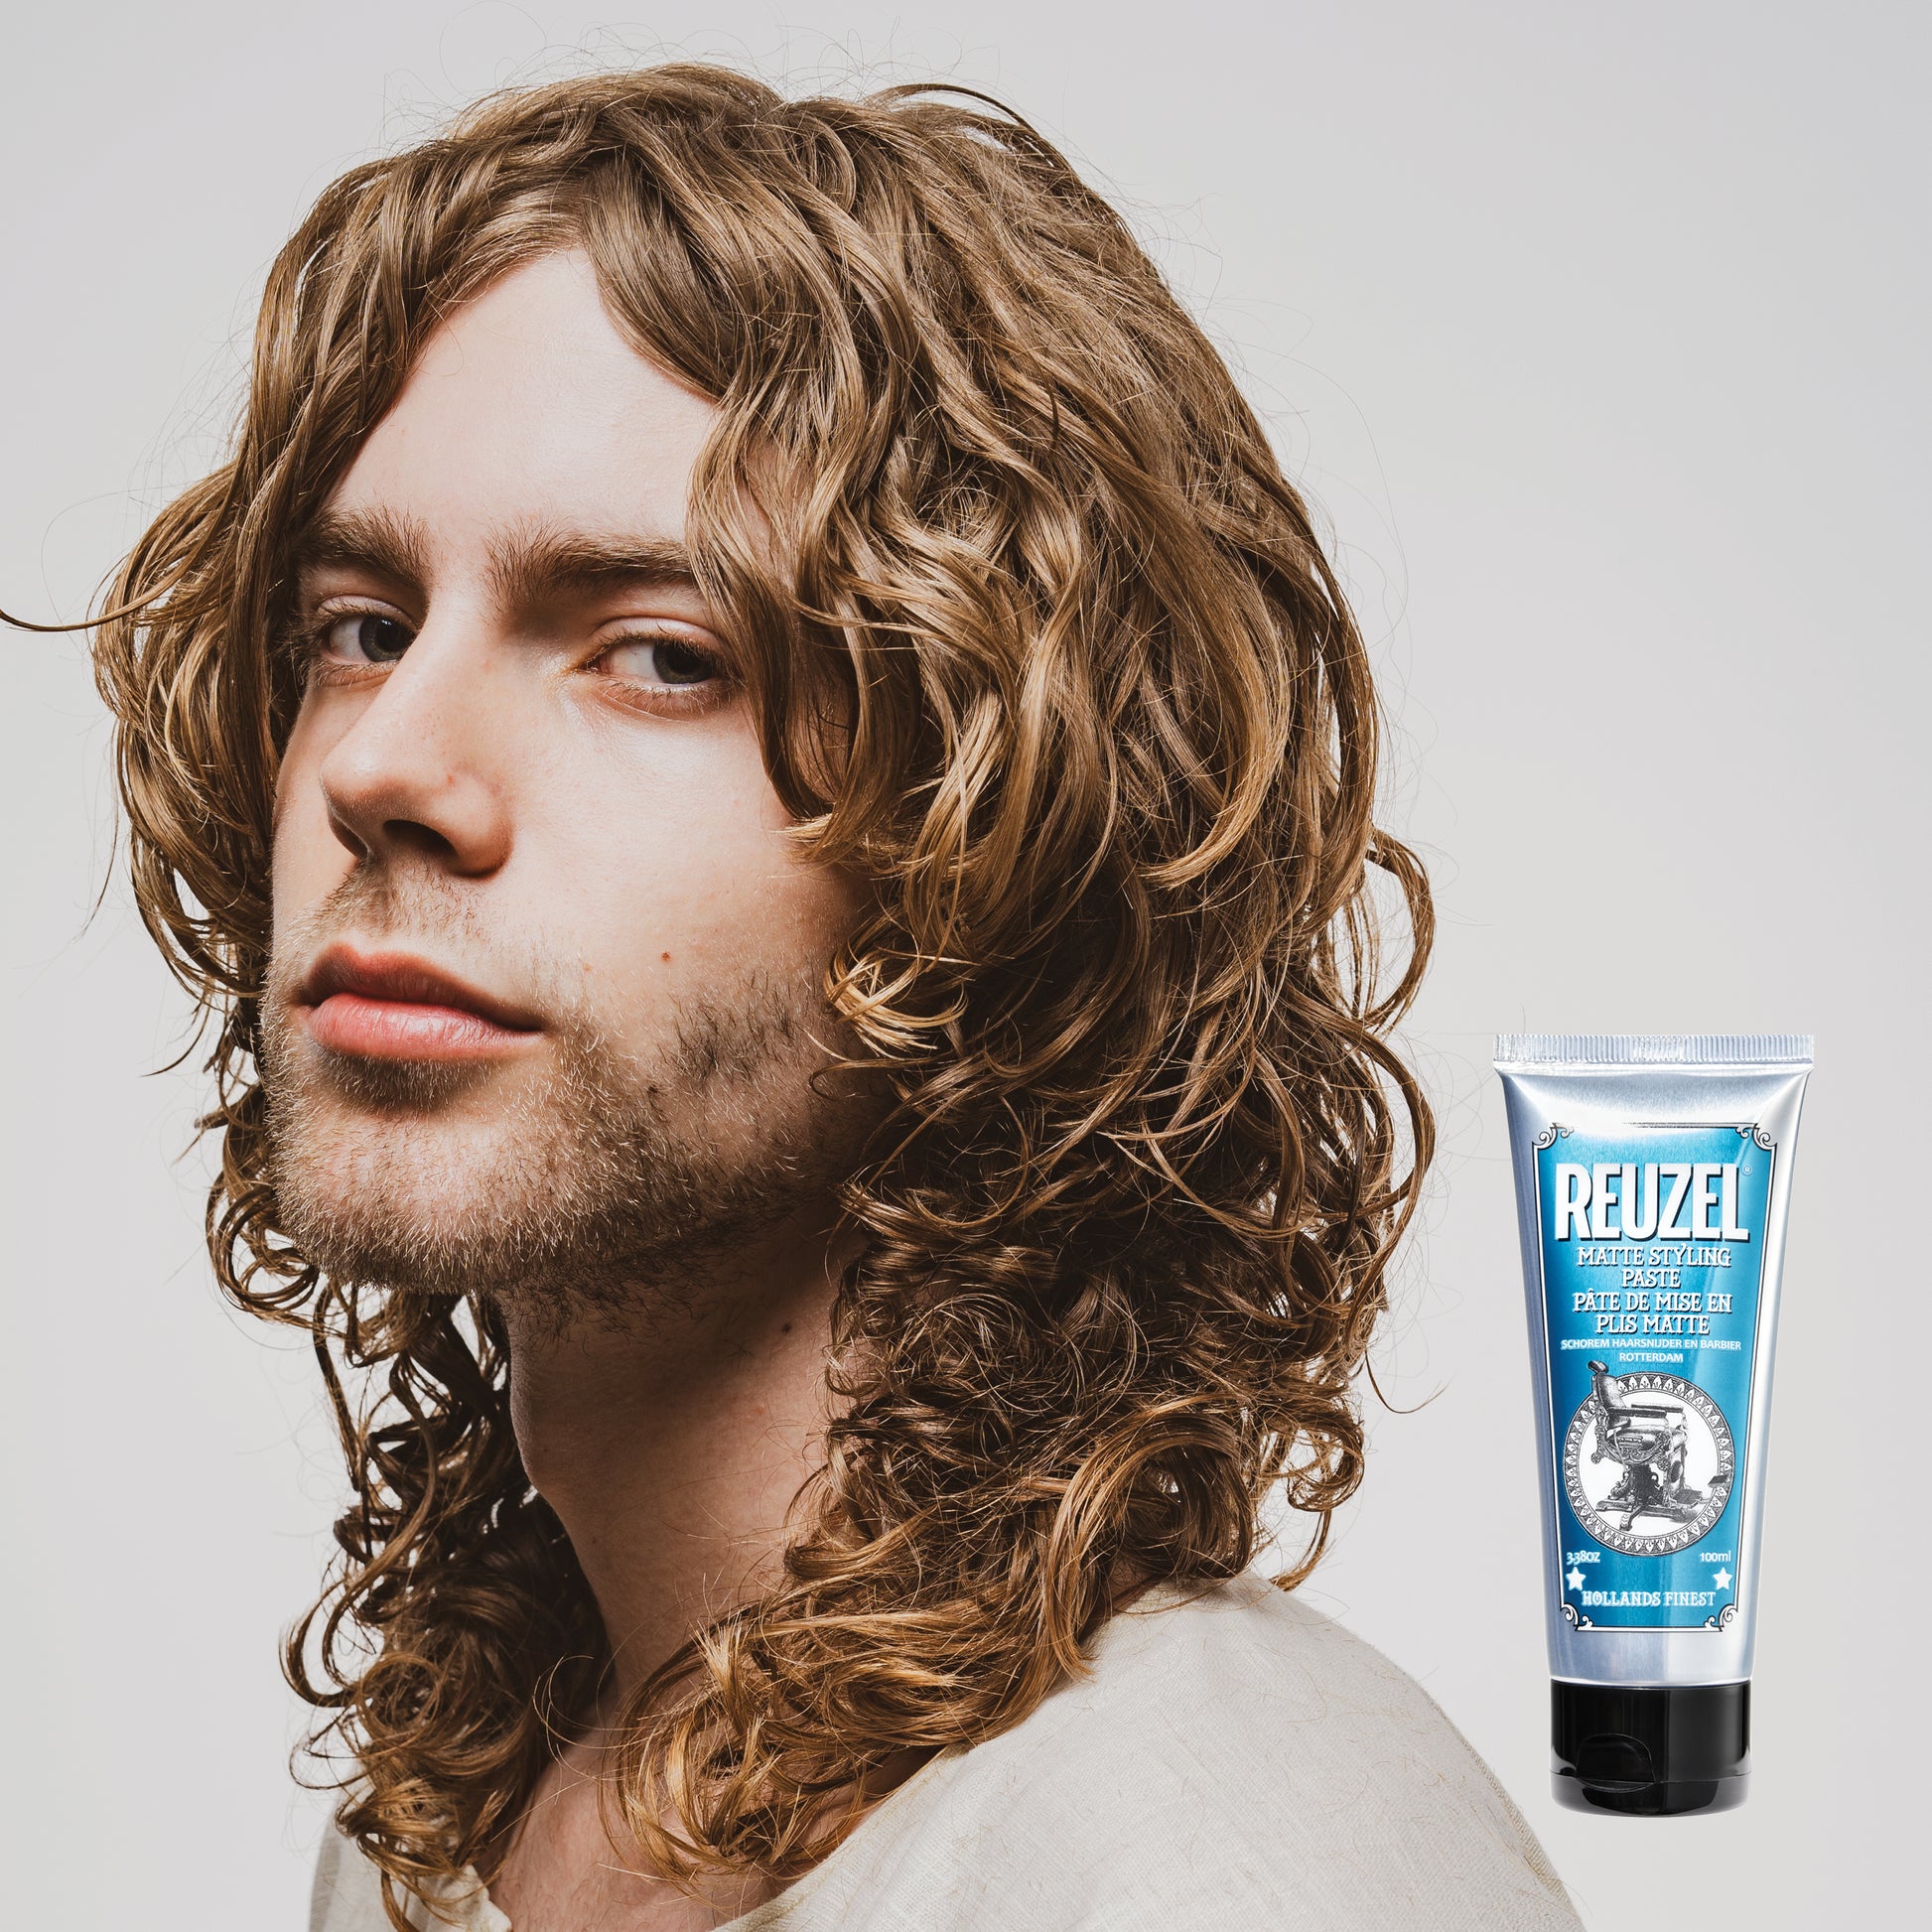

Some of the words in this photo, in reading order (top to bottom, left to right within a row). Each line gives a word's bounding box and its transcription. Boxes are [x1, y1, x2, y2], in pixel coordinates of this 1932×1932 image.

[1555, 1163, 1750, 1243] REUZEL
[1578, 1247, 1644, 1267] MATTE
[1648, 1243, 1731, 1267] STYLING
[1621, 1269, 1681, 1289] PASTE
[1573, 1288, 1621, 1312] PÂTE
[1625, 1293, 1651, 1311] DE
[1654, 1293, 1703, 1312] MISE
[1707, 1294, 1732, 1312] EN
[1596, 1314, 1638, 1334] PLIS
[1642, 1314, 1710, 1335] MATTE
[1561, 1339, 1609, 1350] SCHOREM
[1685, 1339, 1698, 1349] EN
[1701, 1340, 1741, 1350] BARBIER
[1619, 1352, 1684, 1363] ROTTERDAM
[1700, 1550, 1731, 1563] 100ml
[1582, 1590, 1661, 1607] HOLLANDS
[1664, 1591, 1717, 1606] FINEST
